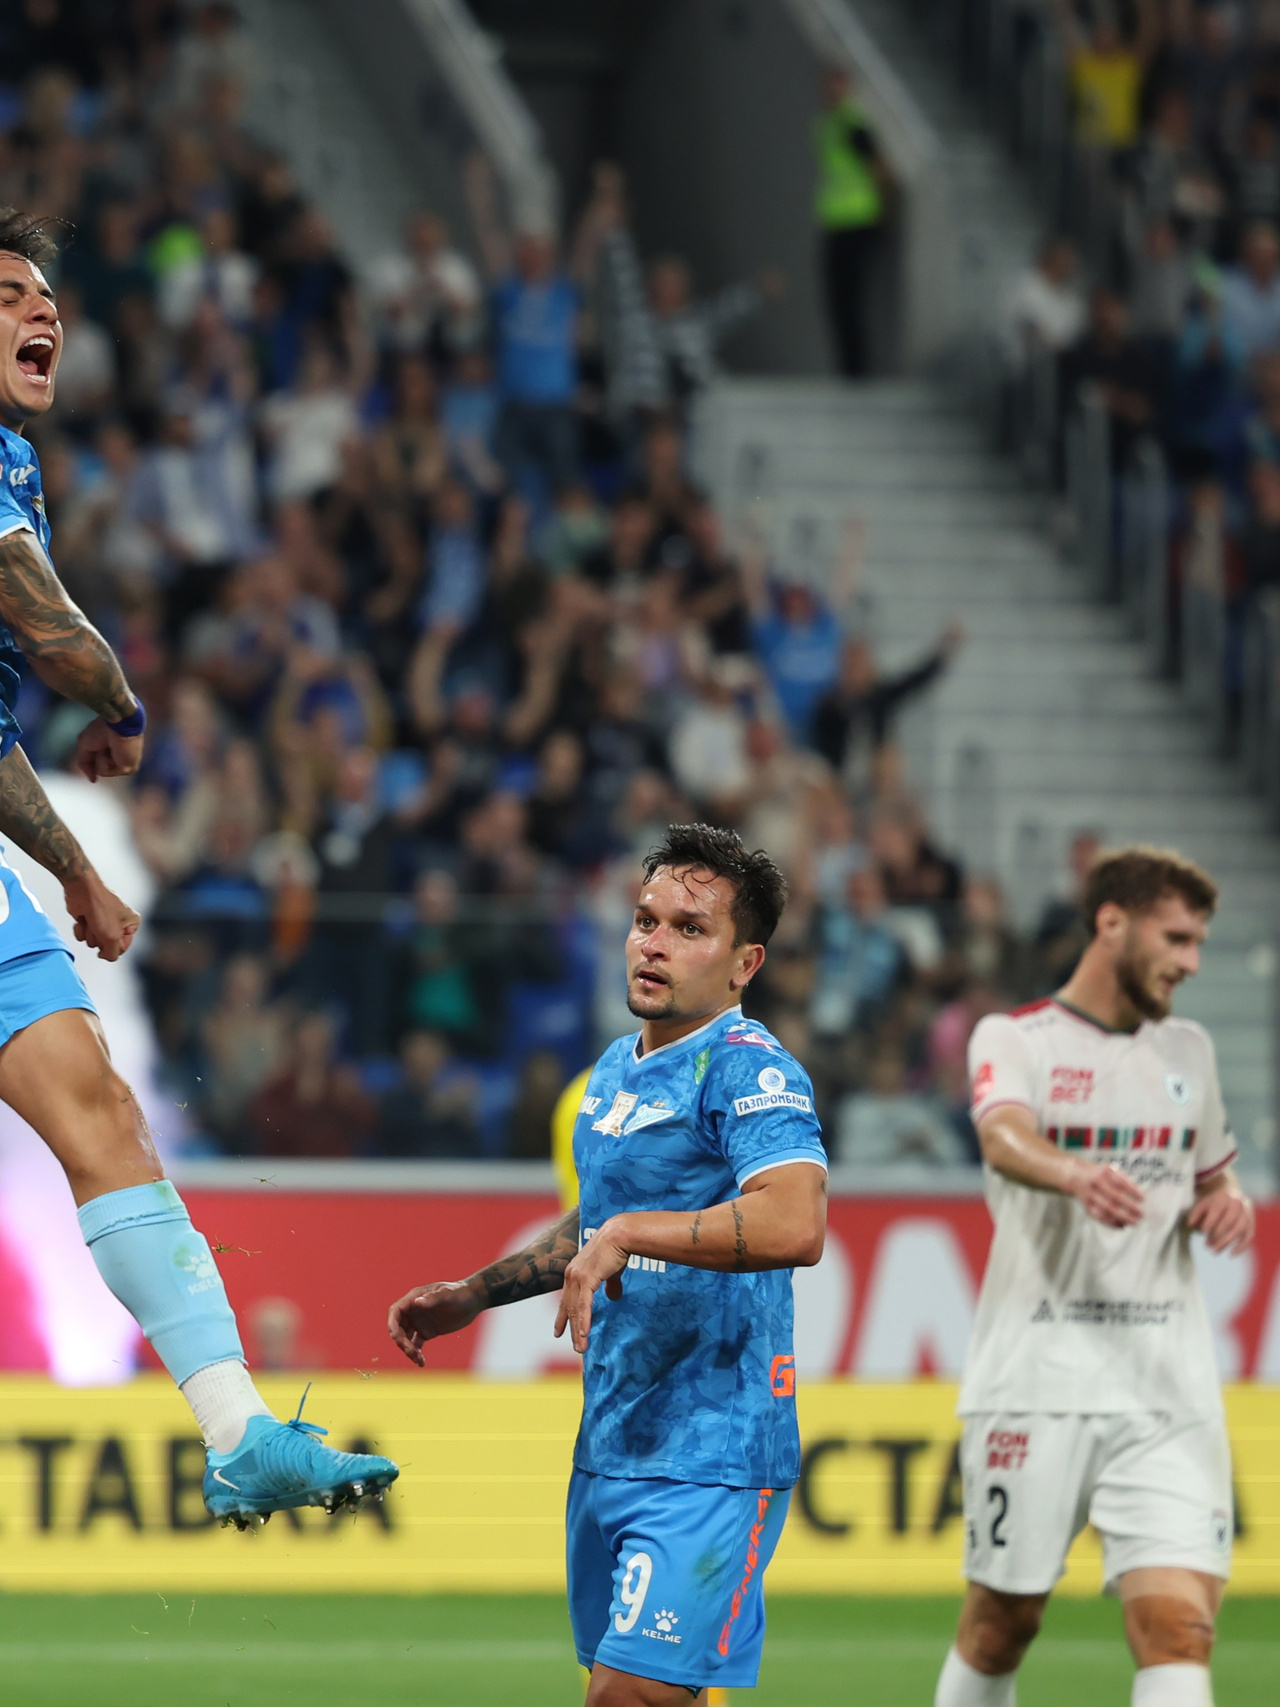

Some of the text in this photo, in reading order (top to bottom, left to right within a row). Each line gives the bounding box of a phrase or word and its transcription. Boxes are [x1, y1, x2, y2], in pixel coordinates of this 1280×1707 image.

[738, 1094, 807, 1112] ГАЗПРОМБАНК
[986, 1431, 1030, 1448] FON
[986, 1450, 1029, 1469] BET
[987, 1484, 1008, 1547] 2
[614, 1552, 653, 1633] 9
[641, 1628, 682, 1644] KELME
